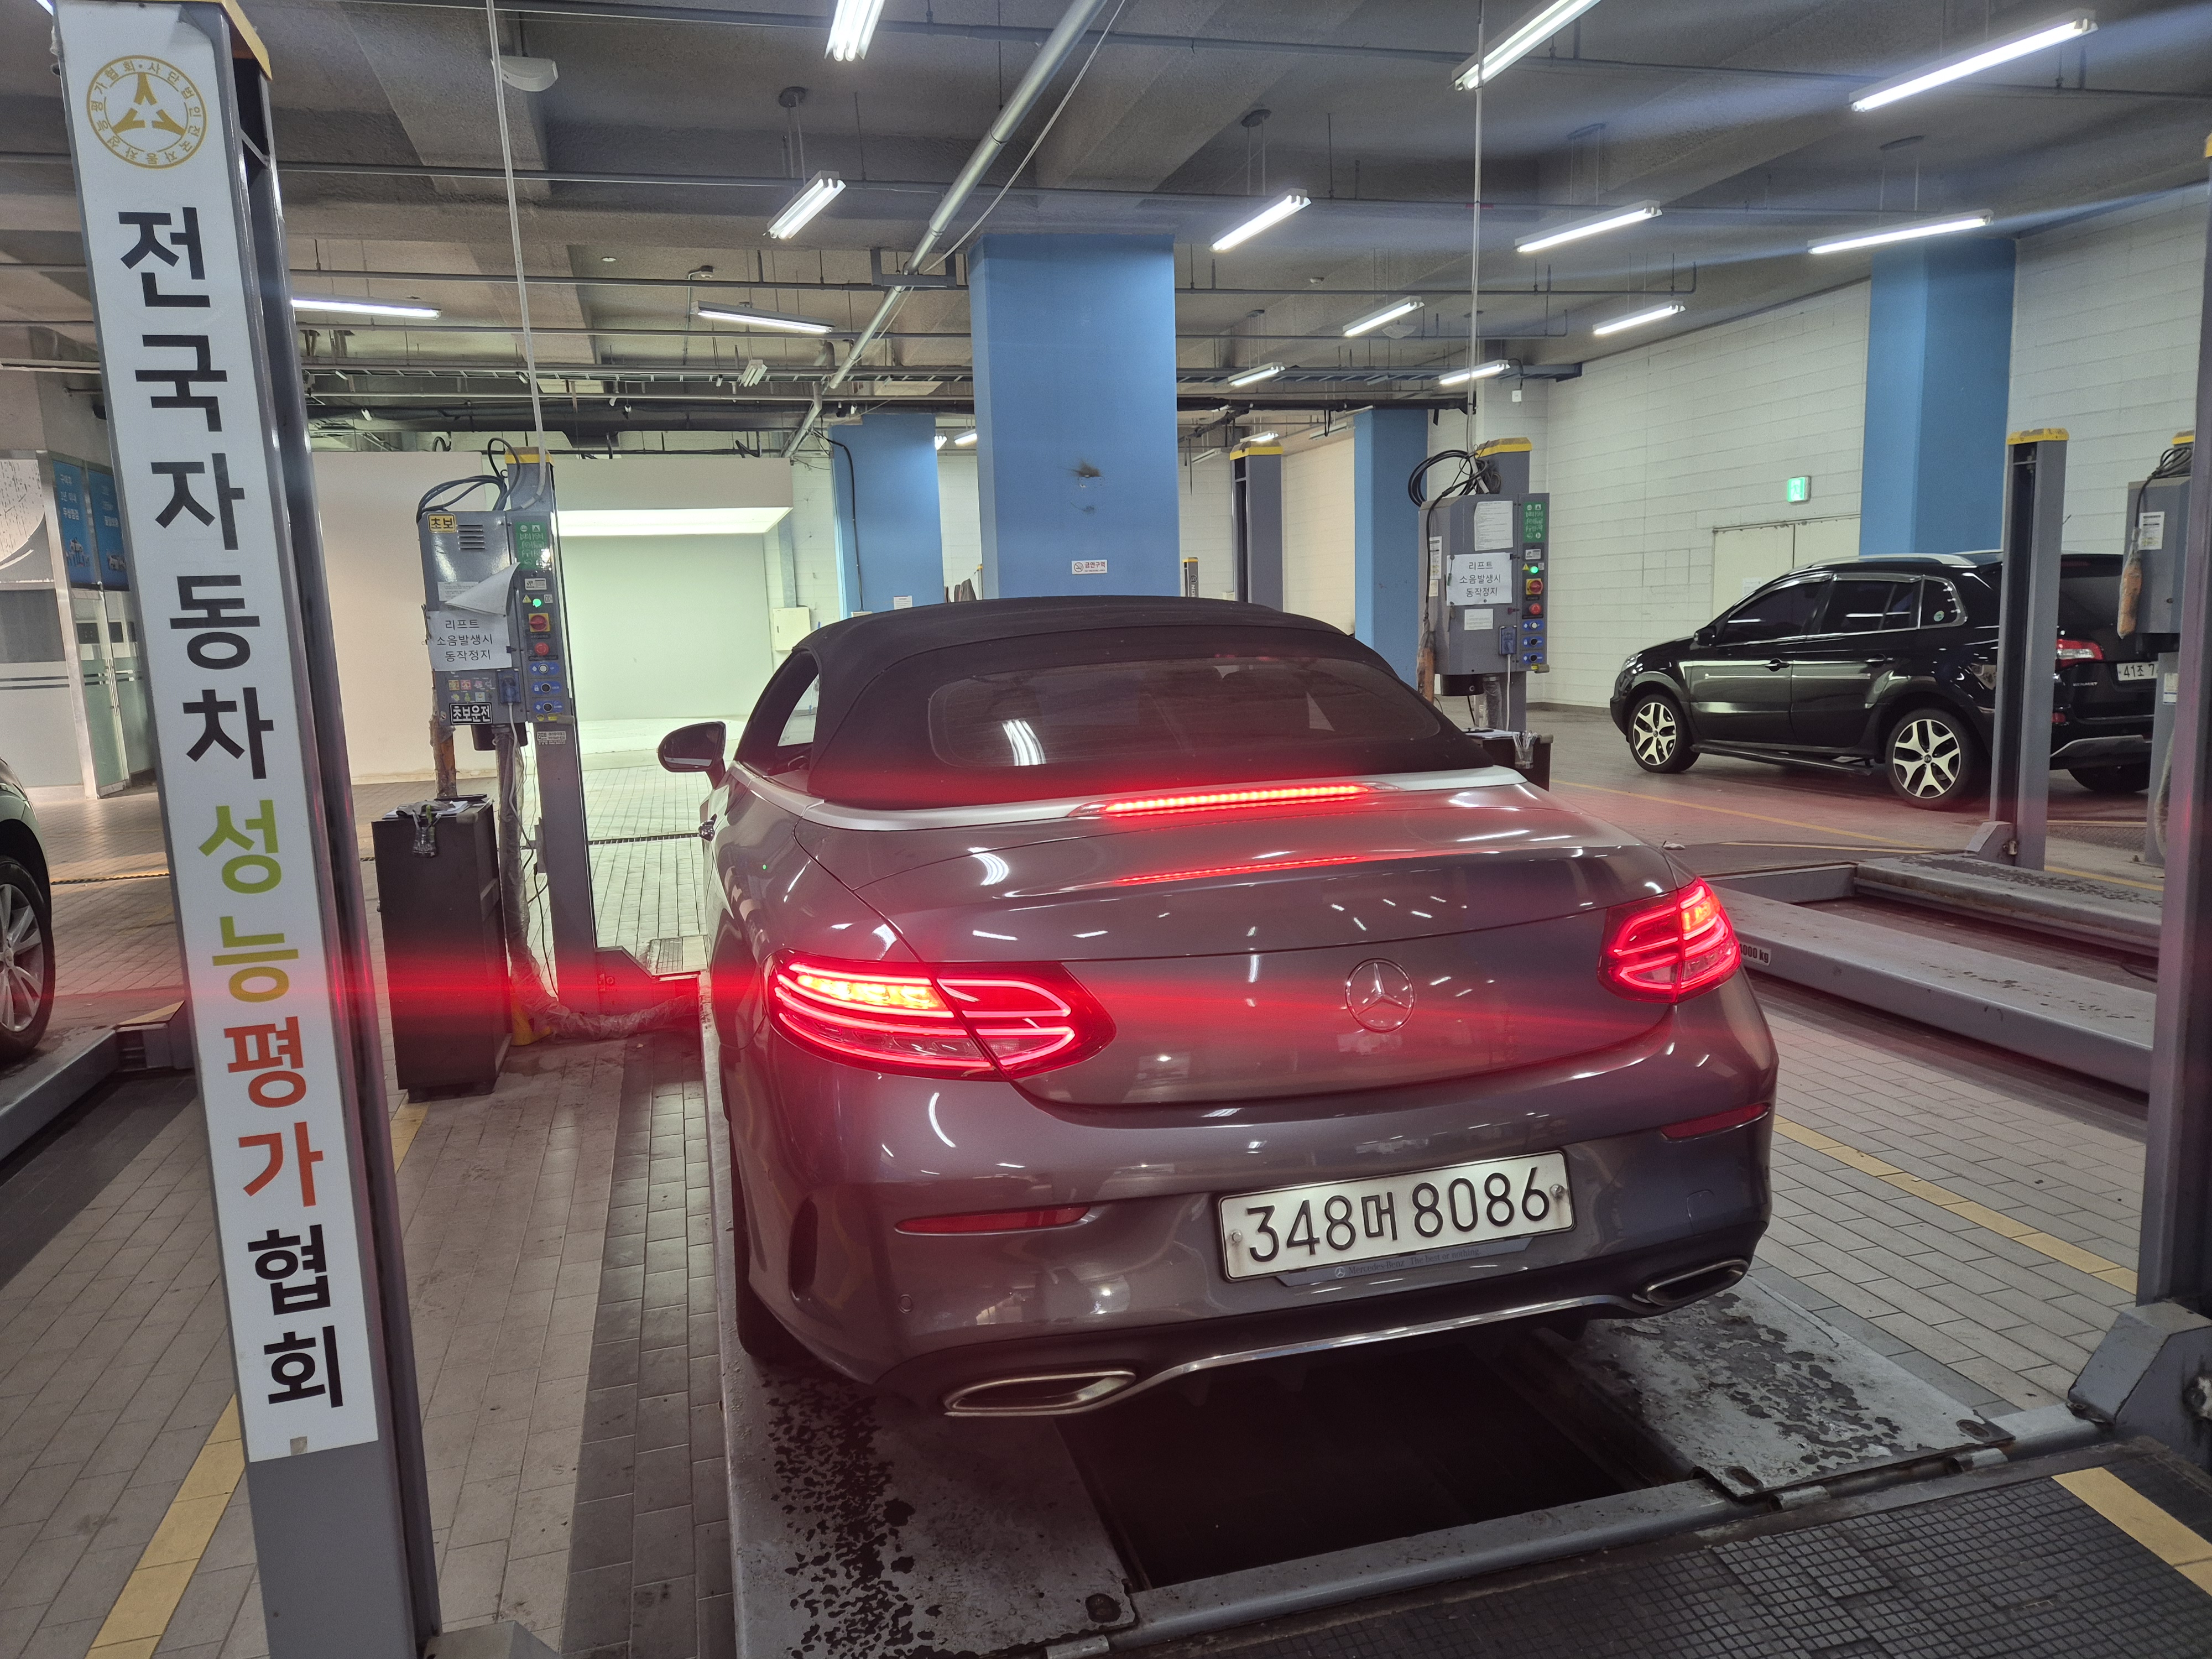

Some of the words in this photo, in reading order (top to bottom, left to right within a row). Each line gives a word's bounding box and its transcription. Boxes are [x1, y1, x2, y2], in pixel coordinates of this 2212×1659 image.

[431, 518, 453, 529] 초보
[1469, 561, 1493, 570] 리프트
[1459, 574, 1501, 584] 소음발생시
[1465, 587, 1498, 597] 동작정지
[445, 619, 479, 630] 리프트
[437, 634, 493, 646] 소음발생시
[445, 649, 491, 662] 동작정지
[2124, 665, 2145, 677] 41조
[453, 705, 491, 722] 초보운전
[1759, 949, 1769, 963] kg
[1246, 1192, 1397, 1262] 348머
[1412, 1167, 1550, 1238] 8086
[1348, 1260, 1405, 1274] Mercedes-Benz
[1410, 1256, 1423, 1265] The
